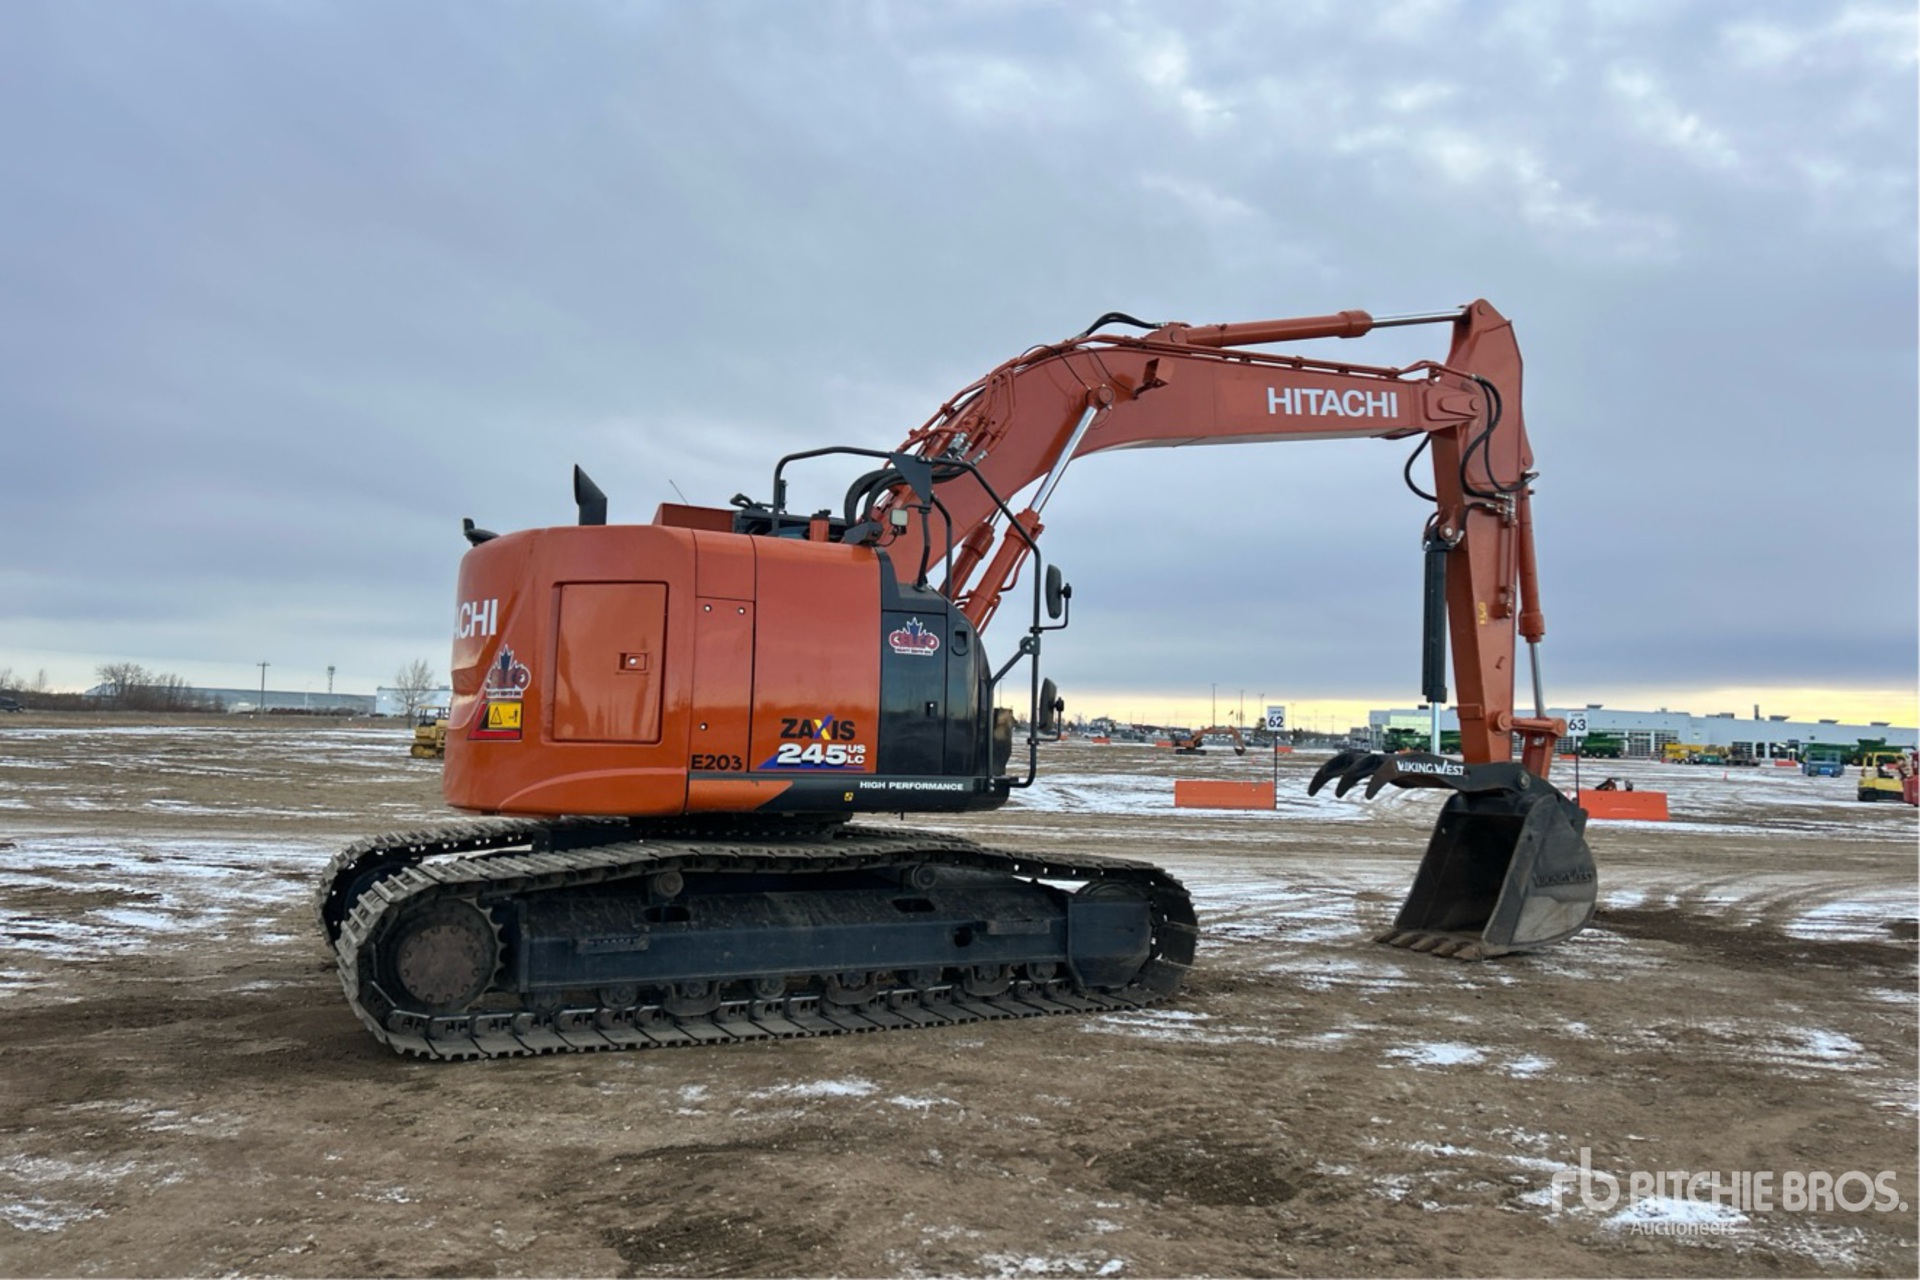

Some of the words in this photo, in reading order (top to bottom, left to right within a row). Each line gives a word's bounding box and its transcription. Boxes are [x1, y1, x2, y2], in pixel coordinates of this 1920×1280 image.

[1267, 387, 1398, 418] HITACHI
[456, 599, 498, 639] CHI
[780, 715, 855, 741] ZAXIS
[1268, 716, 1284, 728] 62
[1569, 718, 1586, 731] 63
[777, 743, 847, 766] 245
[847, 744, 866, 755] US
[691, 754, 742, 771] E203
[846, 755, 866, 765] LC
[1397, 761, 1433, 774] VIKING
[1434, 760, 1464, 776] WEST
[860, 781, 886, 790] HIGH
[889, 781, 964, 791] PERFORMANCE
